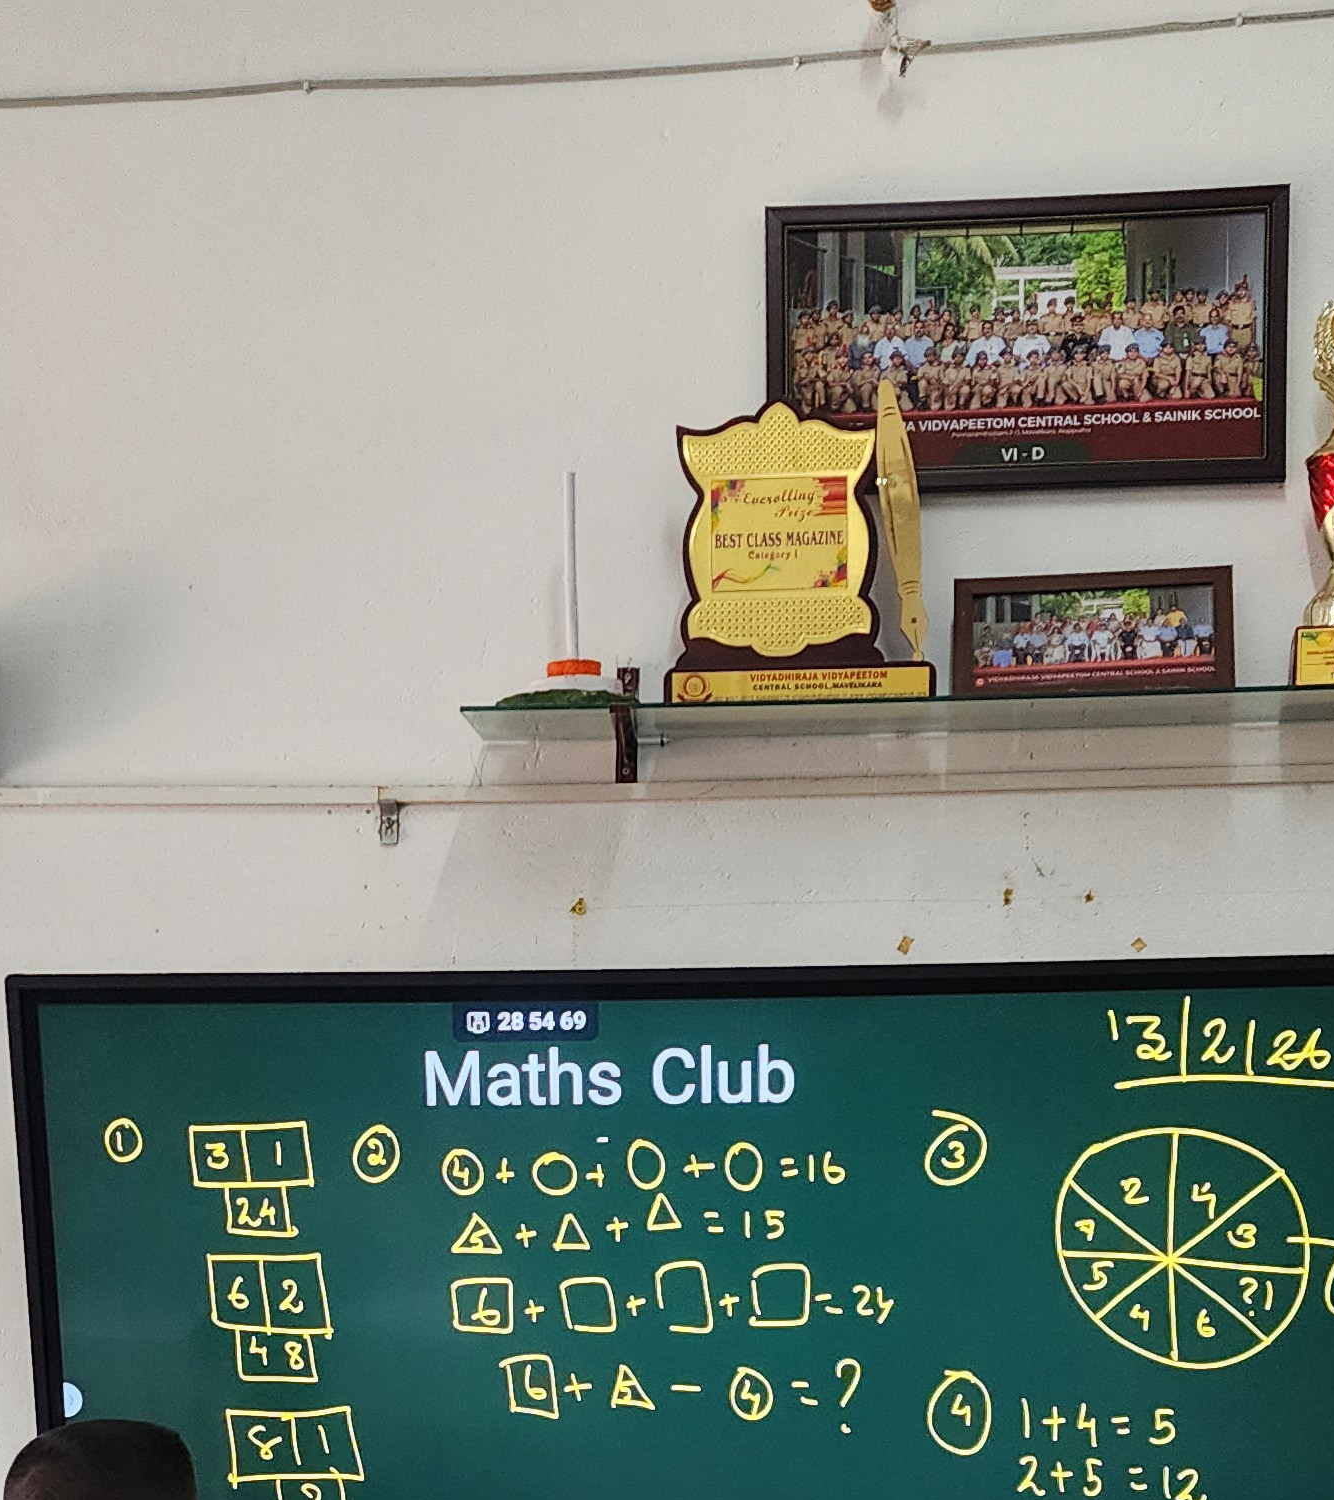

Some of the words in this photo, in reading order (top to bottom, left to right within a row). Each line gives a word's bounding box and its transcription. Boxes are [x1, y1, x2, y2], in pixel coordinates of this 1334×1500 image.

[918, 417, 1015, 433] VIDYAPEETOM
[1018, 414, 1081, 428] CENTRAL
[1083, 411, 1140, 425] SCHOOL
[1142, 411, 1151, 422] &
[1154, 409, 1201, 422] SAINIK
[1204, 407, 1262, 420] SCHOOL
[1001, 448, 1017, 462] VI
[1032, 446, 1045, 460] D
[774, 505, 813, 522] Prize
[714, 533, 743, 549] BEST
[746, 531, 782, 547] CLASS
[786, 529, 844, 547] MAGAZINE
[748, 551, 791, 560] Category
[750, 673, 819, 682] VIDYADHIRAJA
[821, 671, 888, 681] VIDYAPEETOM
[497, 1011, 524, 1031] 28
[529, 1011, 555, 1031] 54
[560, 1010, 587, 1031] 69
[424, 1049, 622, 1107] Maths
[651, 1044, 796, 1104] Club
[203, 1141, 230, 1169] 3
[236, 1196, 278, 1226] 24
[1120, 1177, 1150, 1205] 2
[1191, 1181, 1216, 1219] 4
[1226, 1223, 1258, 1249] 3
[1083, 1261, 1115, 1290] 5
[227, 1279, 250, 1309] 6
[277, 1279, 306, 1314] 2
[247, 1424, 283, 1461] 8
